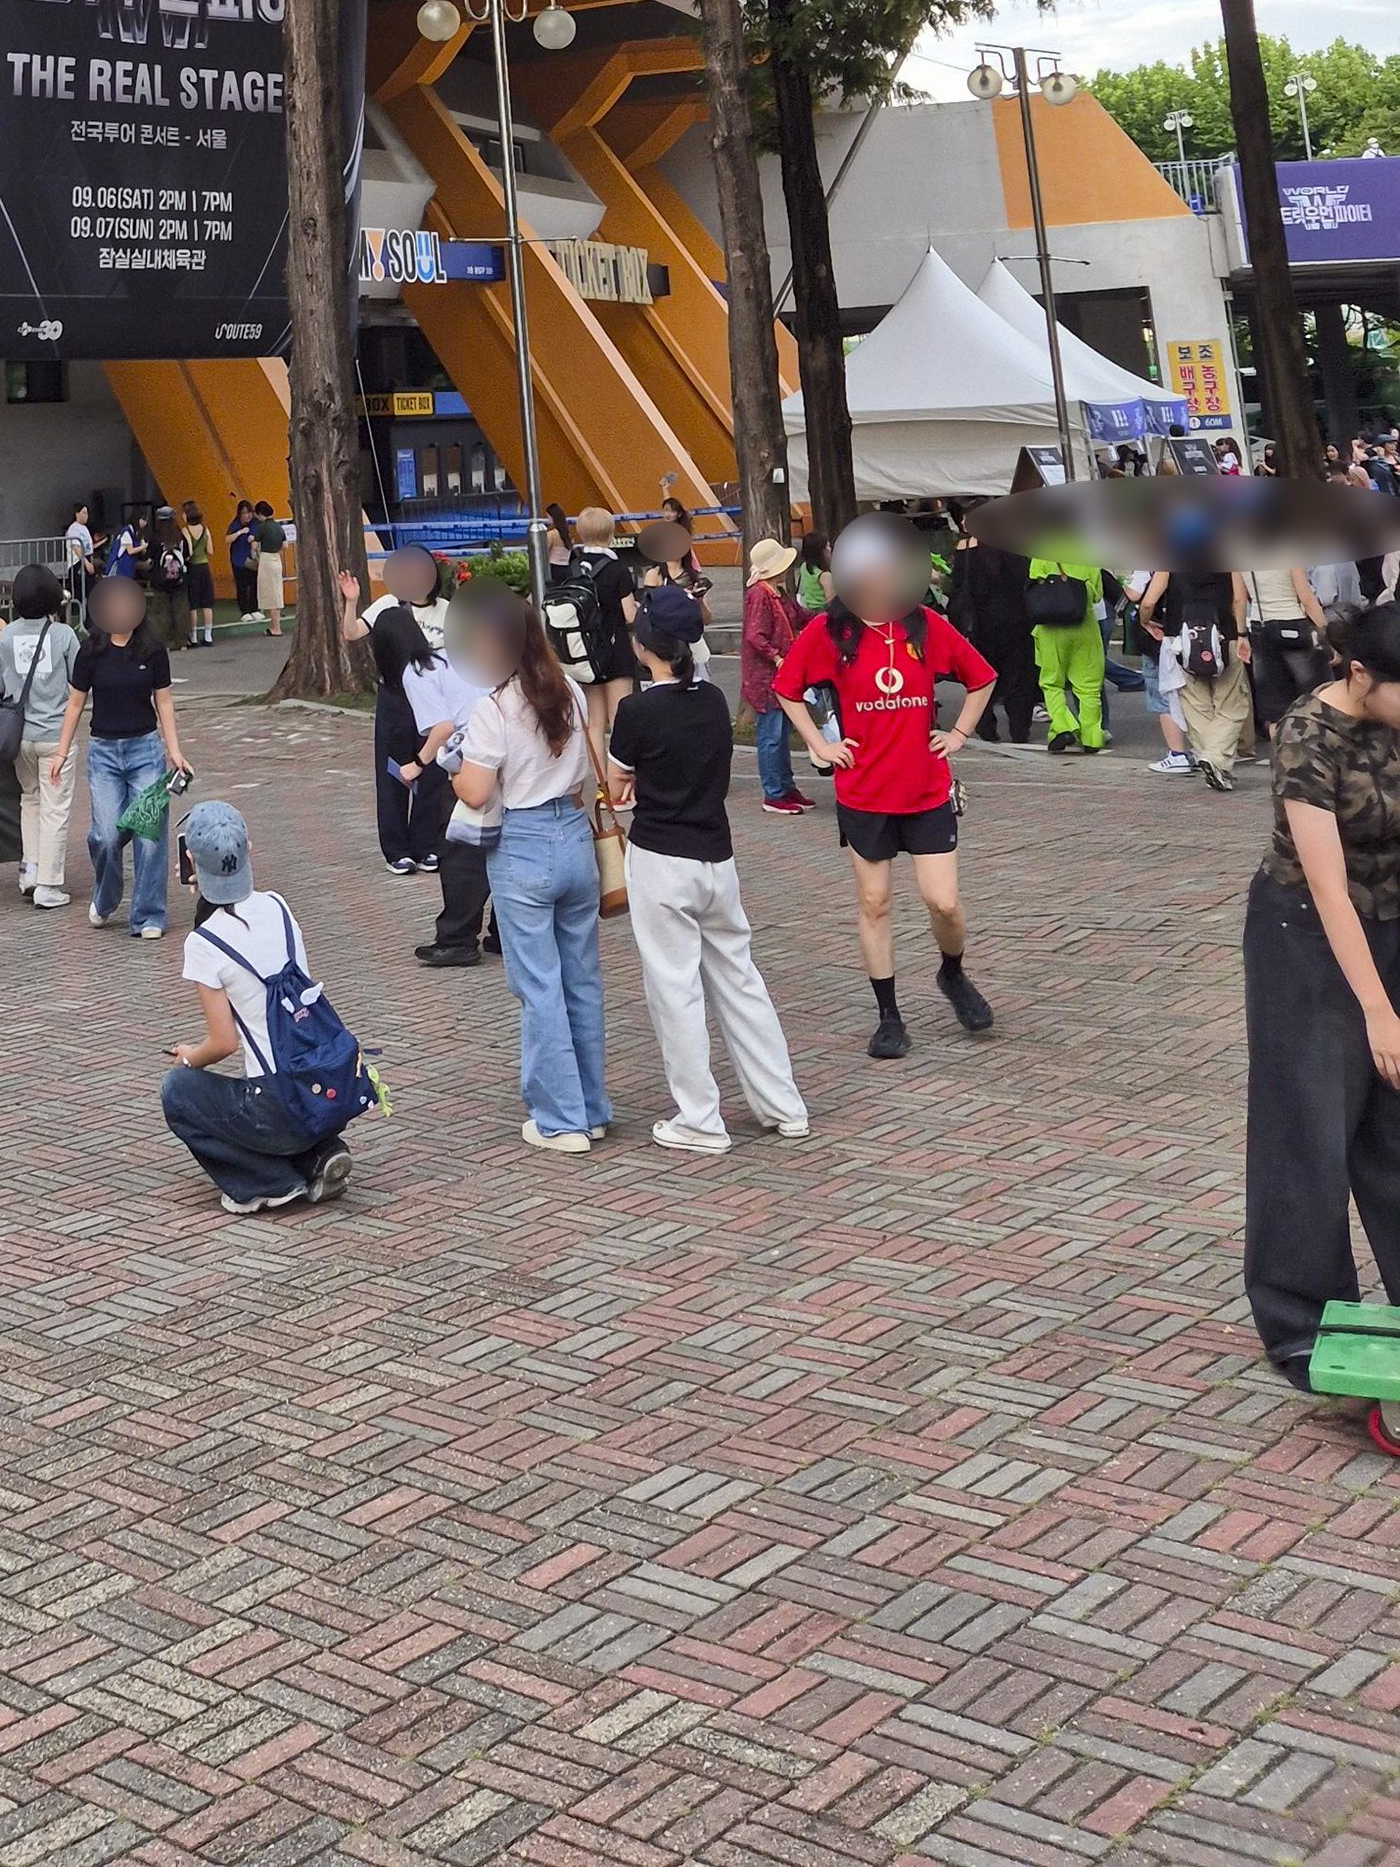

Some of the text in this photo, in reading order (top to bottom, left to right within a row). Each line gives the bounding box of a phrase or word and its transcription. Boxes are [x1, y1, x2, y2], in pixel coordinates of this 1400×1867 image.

[7, 52, 284, 114] THE REAL STAGE
[70, 120, 136, 145] 전국투어
[140, 124, 180, 147] 콘서트
[196, 128, 228, 149] 서울
[72, 186, 154, 210] 09.06(SAT)
[158, 189, 186, 211] 2PM
[202, 191, 232, 212] 7PM
[1282, 185, 1349, 196] WORLD
[1280, 204, 1373, 226] 트릿우먼파이터
[71, 216, 154, 240] 09.07(SUN)
[158, 219, 187, 241] 2PM
[202, 220, 232, 241] 7PM
[98, 247, 207, 270] 잠실실내체육관
[387, 229, 447, 283] SOUL
[855, 695, 928, 712] vodafone
